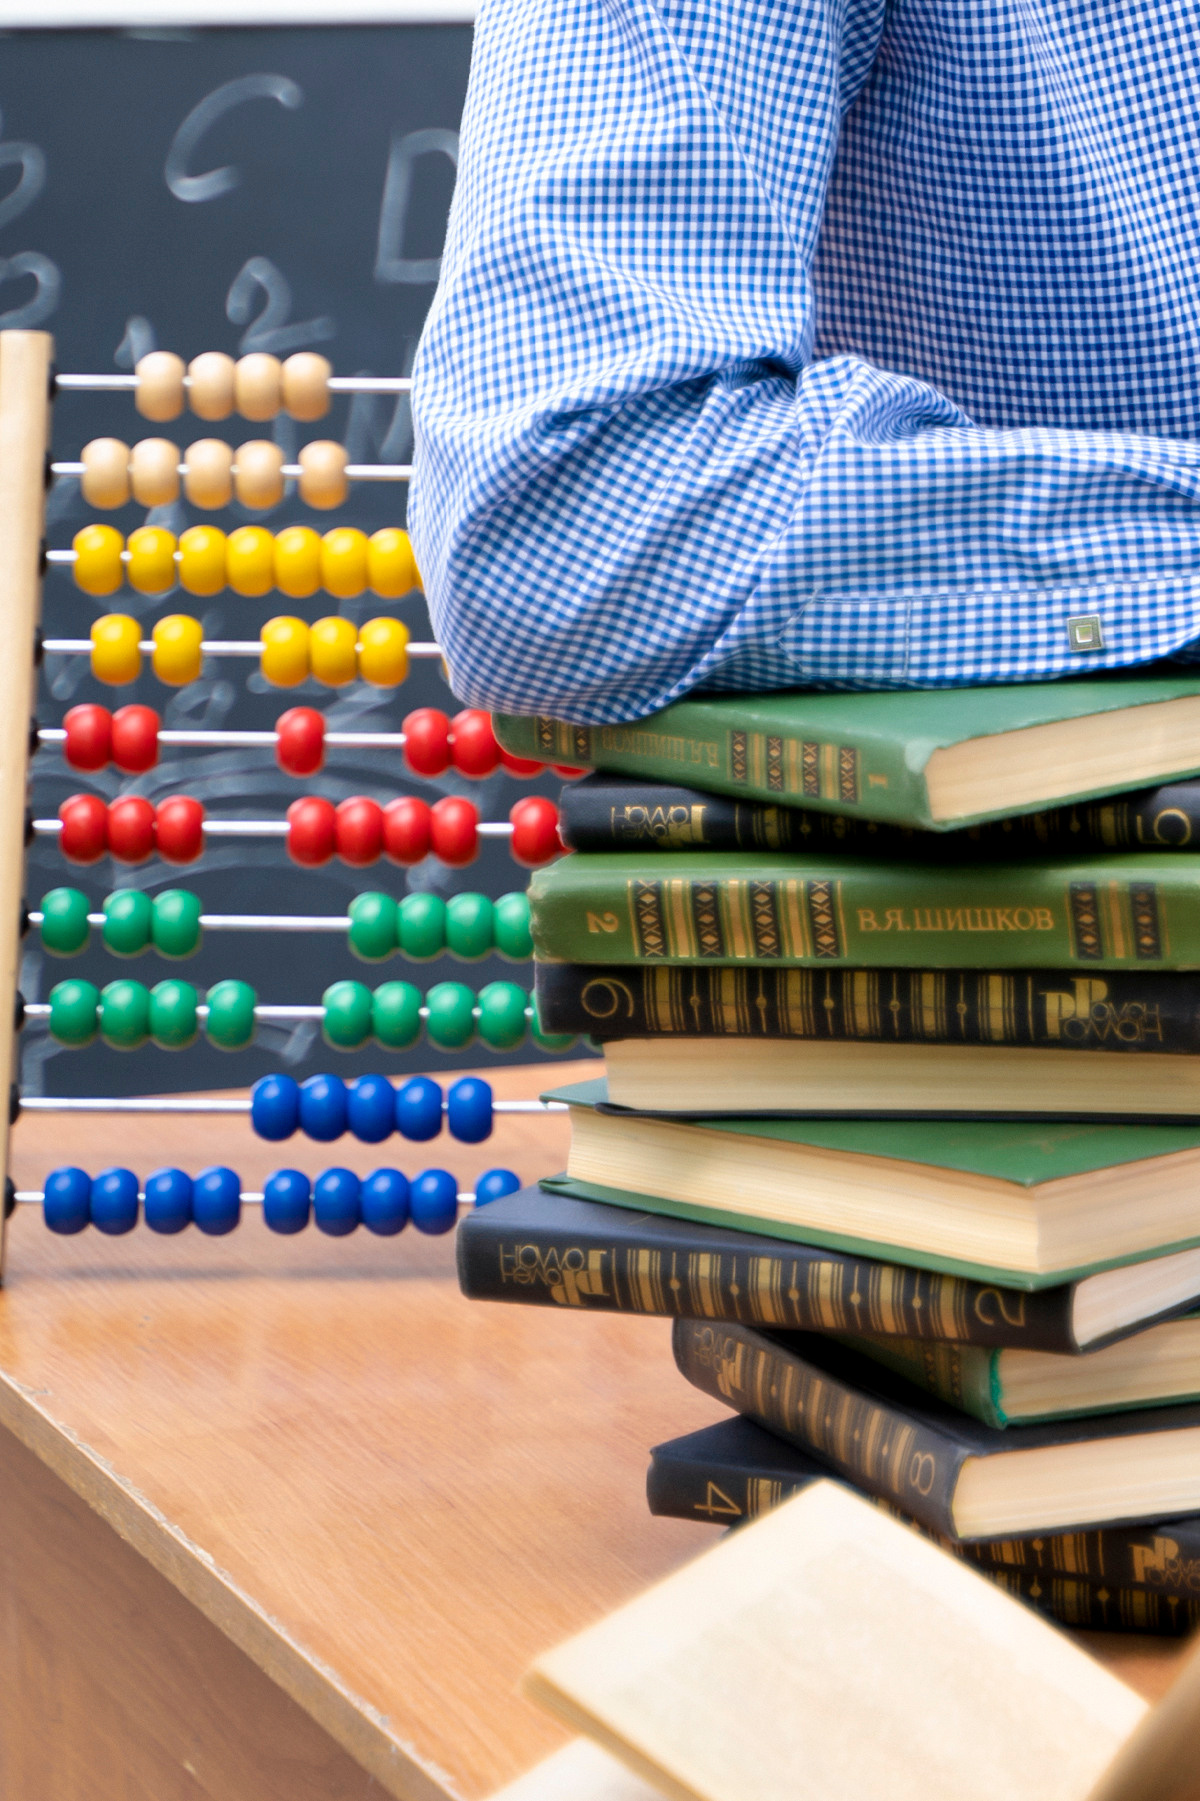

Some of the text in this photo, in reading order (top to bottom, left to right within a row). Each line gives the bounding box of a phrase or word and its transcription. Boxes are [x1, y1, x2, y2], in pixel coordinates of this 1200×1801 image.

[1136, 808, 1191, 846] 5
[585, 911, 619, 934] 2
[975, 1287, 1026, 1327] 2
[909, 1452, 935, 1496] 8
[694, 1481, 741, 1516] 4
